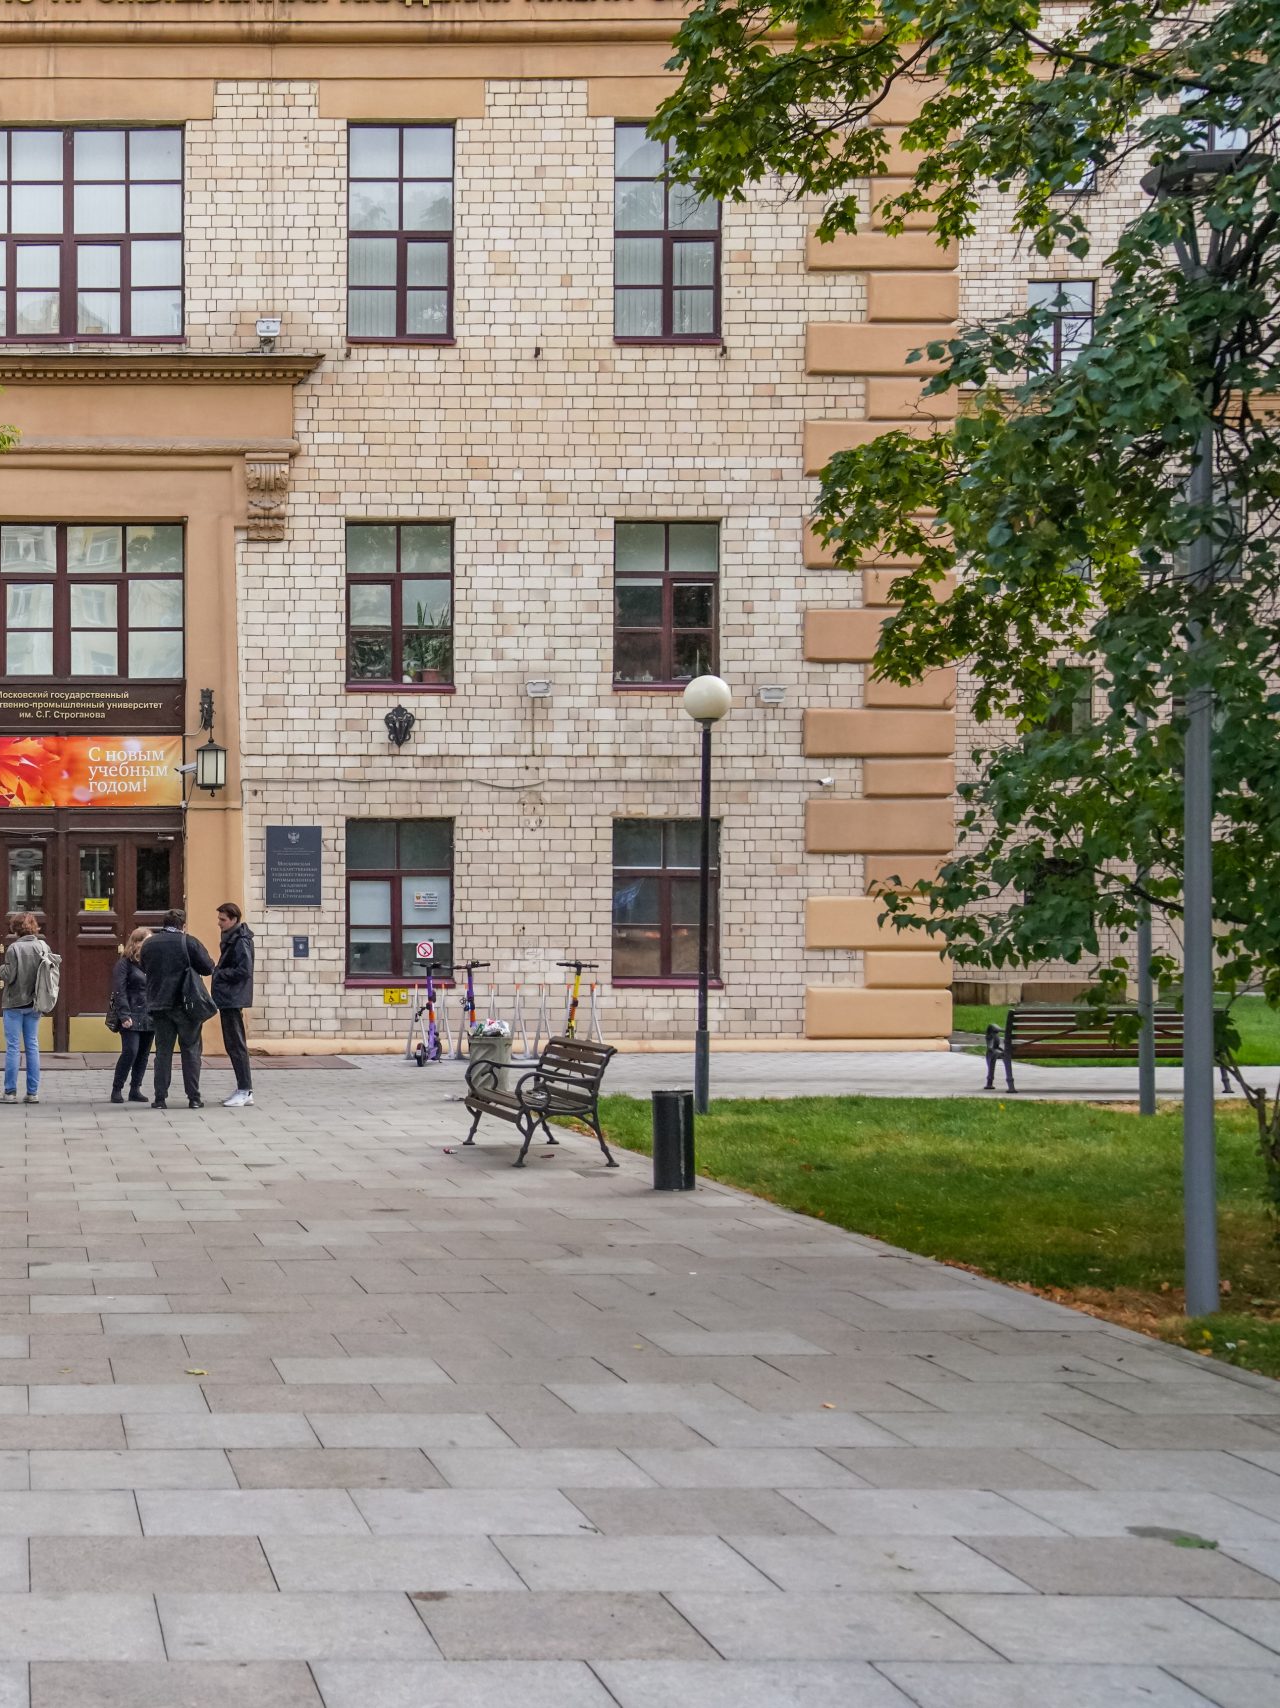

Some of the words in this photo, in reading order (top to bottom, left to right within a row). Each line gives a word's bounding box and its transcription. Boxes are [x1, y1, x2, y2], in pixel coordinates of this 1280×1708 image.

[50, 690, 129, 700] государственный
[106, 702, 163, 710] университет
[35, 710, 51, 718] С.Г.
[53, 710, 106, 720] Строганова
[88, 746, 101, 762] С
[105, 750, 165, 762] новым
[88, 761, 169, 781] учебным
[88, 777, 147, 795] годом!
